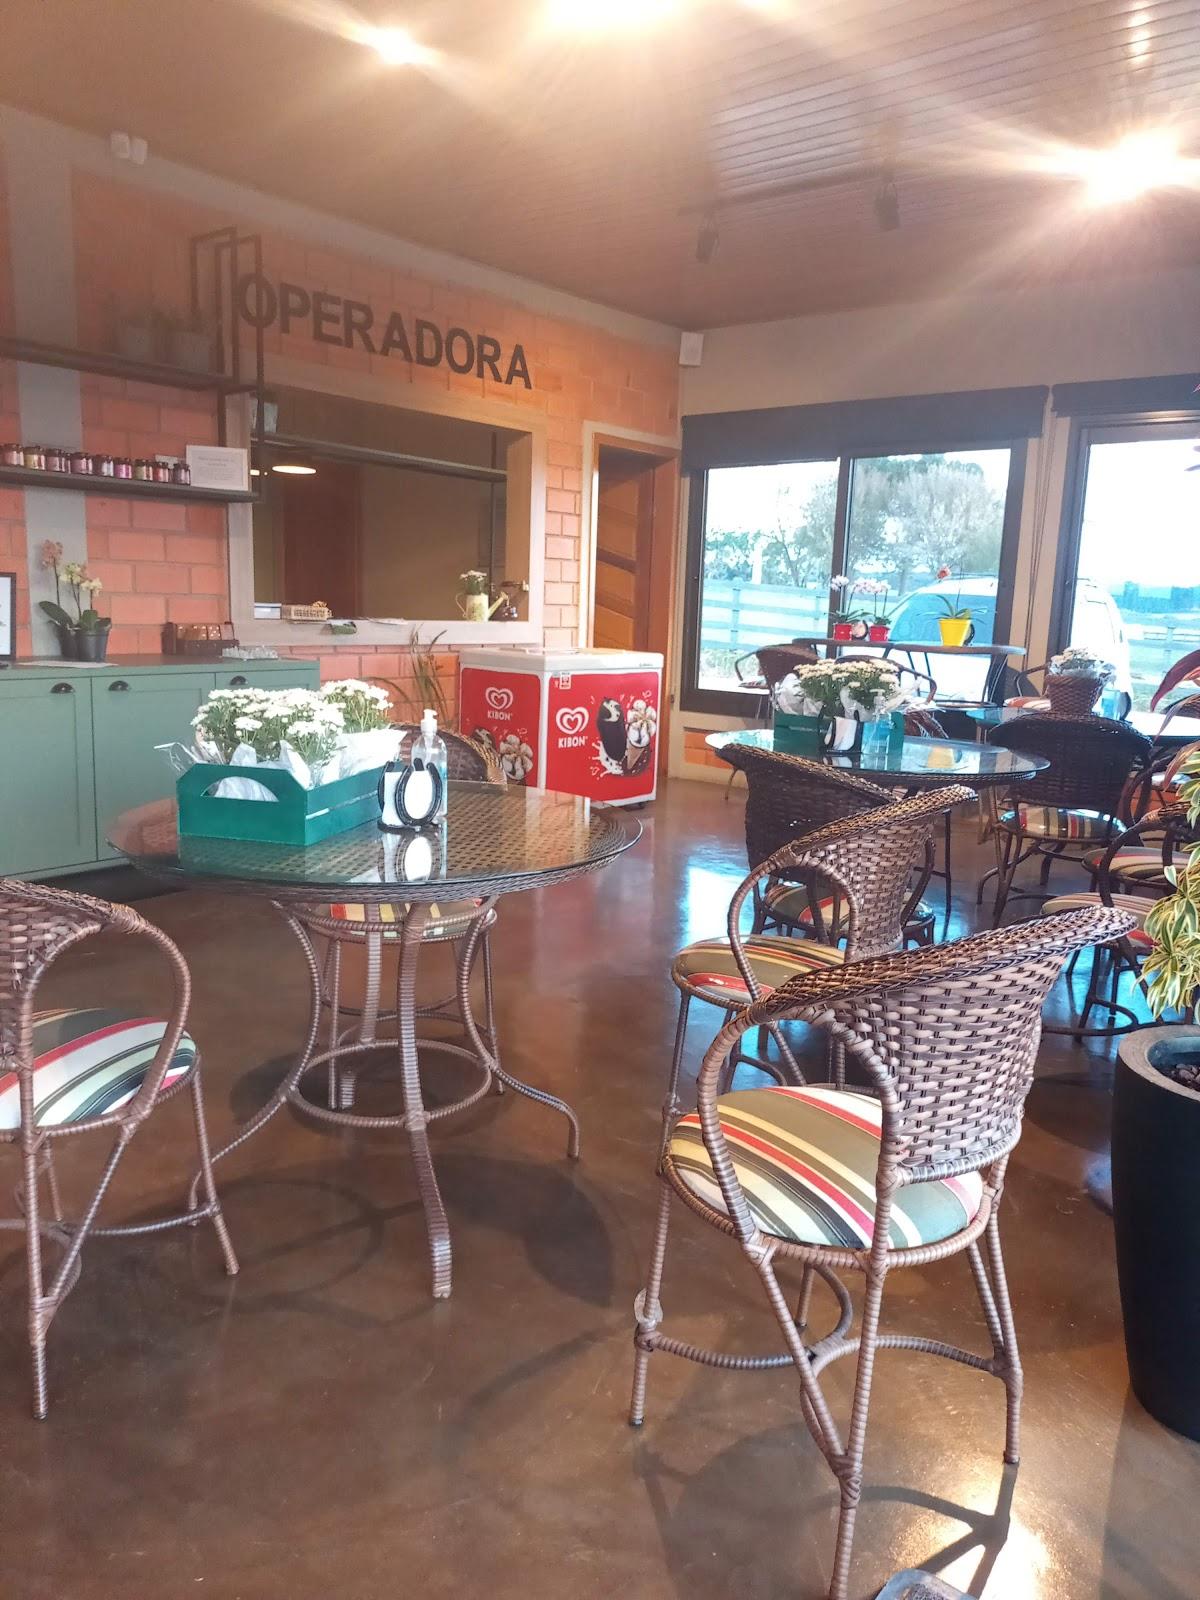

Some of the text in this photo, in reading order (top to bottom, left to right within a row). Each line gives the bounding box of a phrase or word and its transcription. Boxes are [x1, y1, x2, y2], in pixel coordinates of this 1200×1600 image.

[239, 273, 532, 389] OPERADORA
[487, 710, 511, 720] KIBON
[558, 736, 586, 748] KIBON
